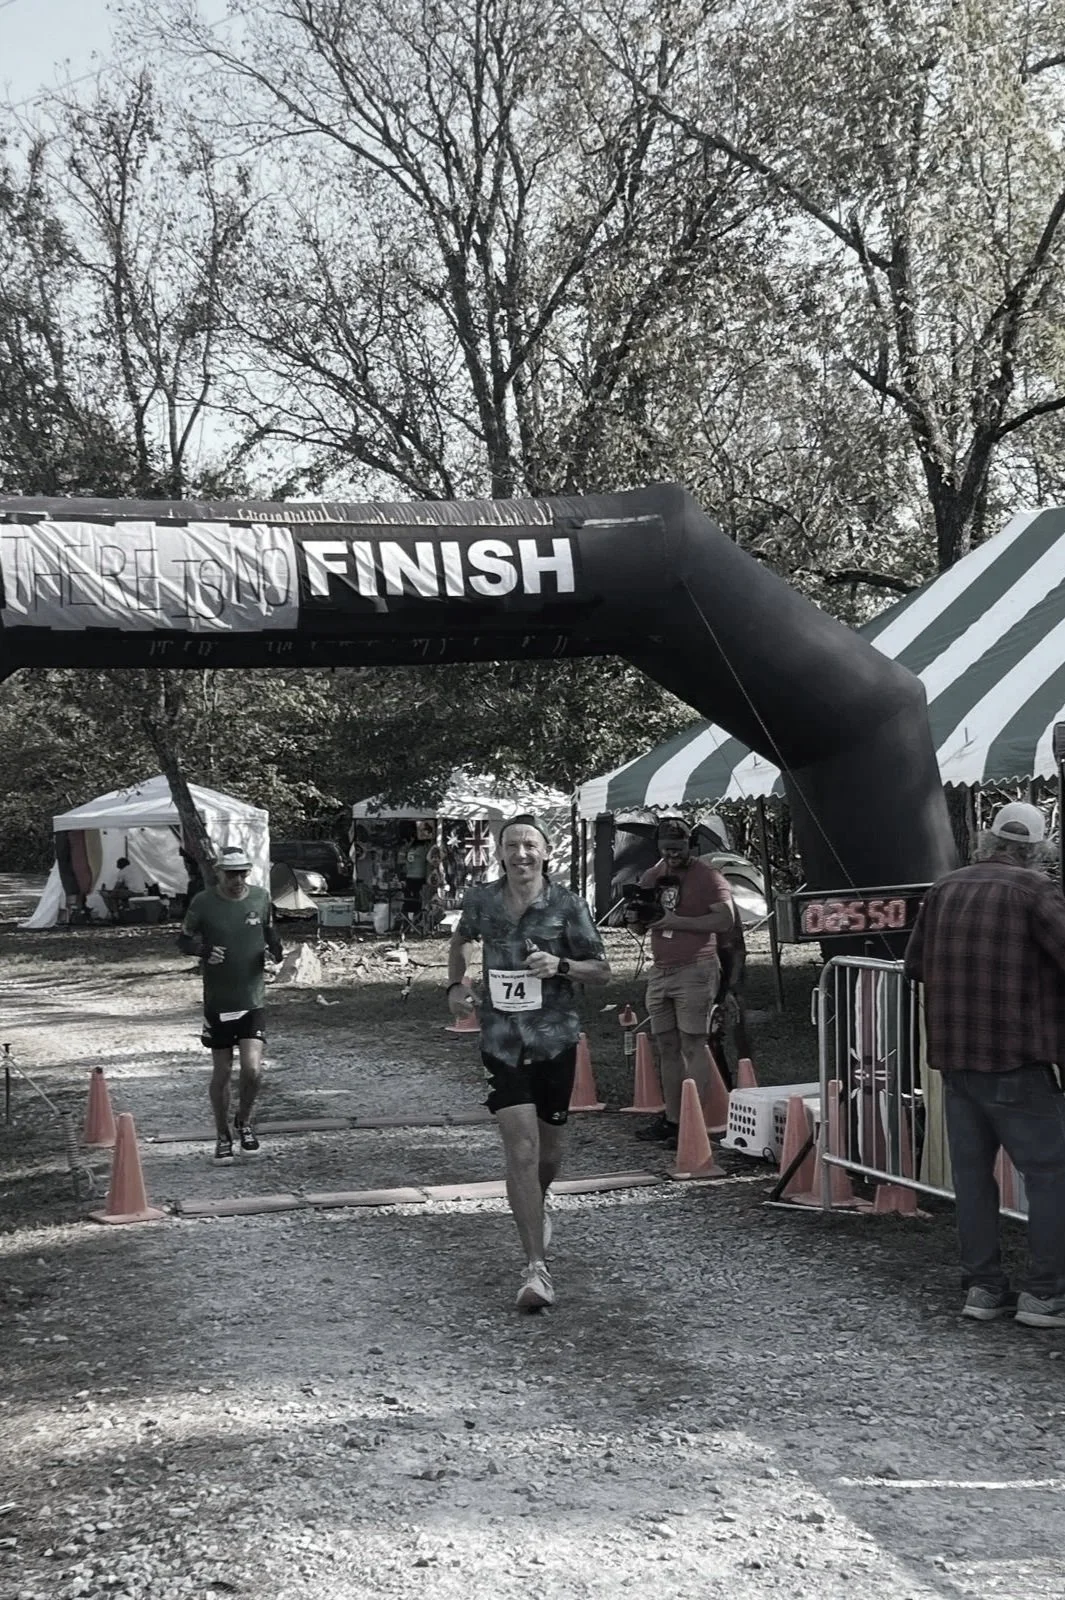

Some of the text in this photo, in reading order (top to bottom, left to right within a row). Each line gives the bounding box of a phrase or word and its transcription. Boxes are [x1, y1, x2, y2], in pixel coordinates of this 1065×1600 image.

[1, 536, 291, 619] THERE IS NO
[302, 537, 576, 598] FINISH
[502, 981, 526, 1000] 74
